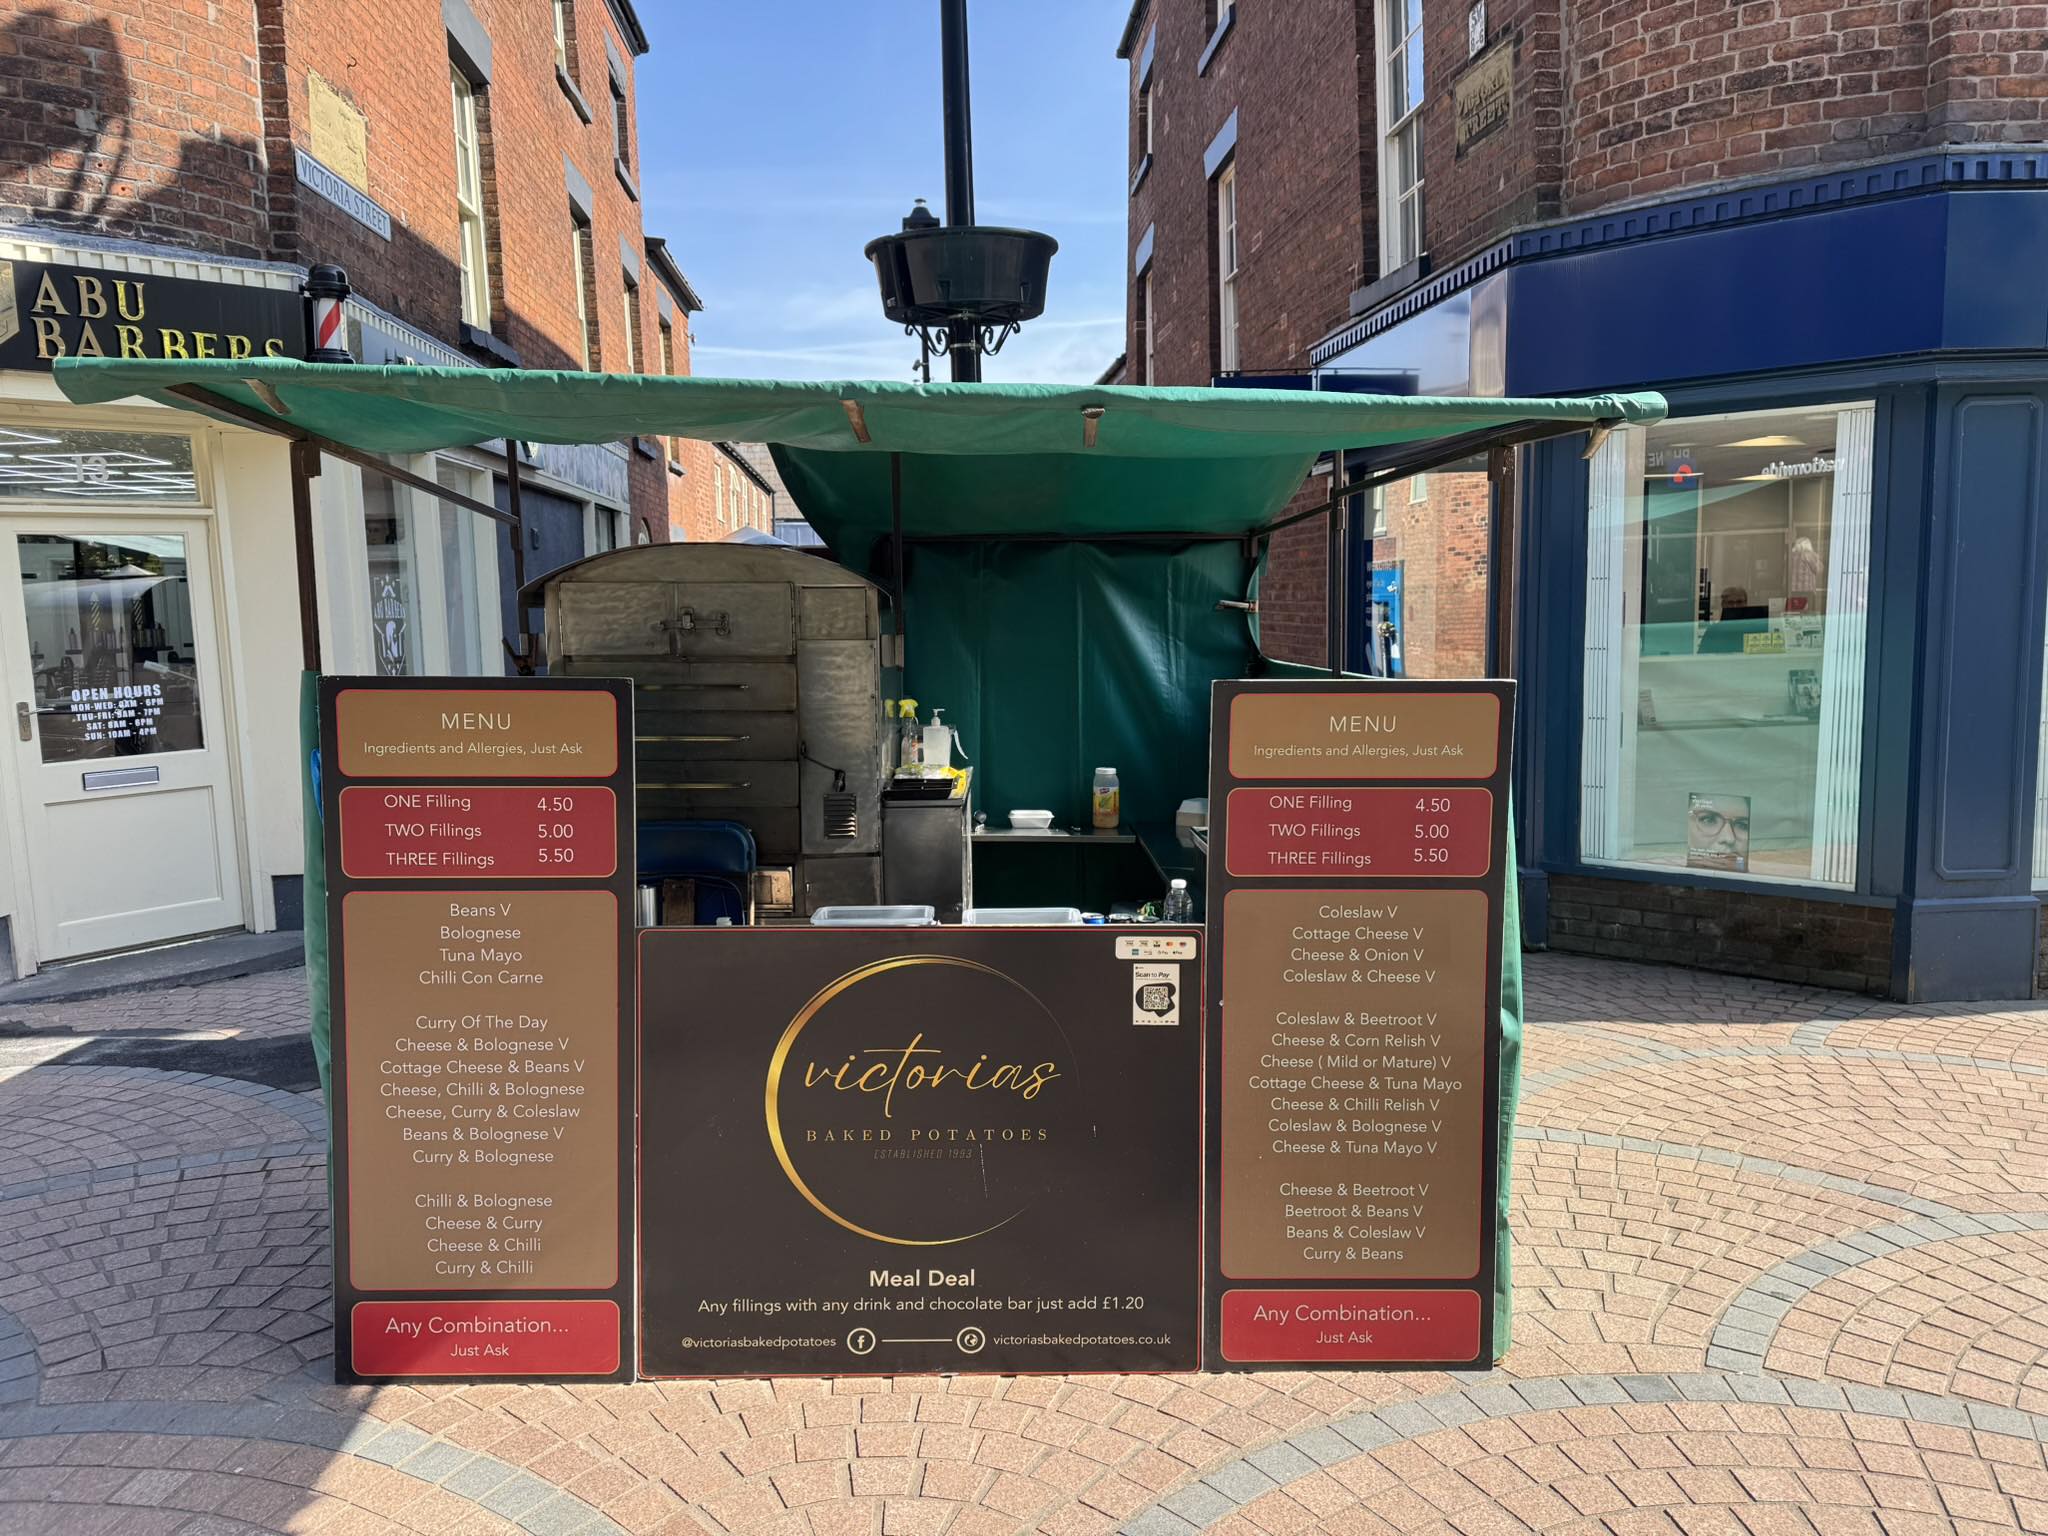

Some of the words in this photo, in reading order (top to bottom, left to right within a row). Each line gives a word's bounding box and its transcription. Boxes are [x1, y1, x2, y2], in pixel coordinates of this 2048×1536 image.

[300, 155, 351, 210] VICTORIA
[353, 195, 387, 234] STREET
[31, 270, 145, 321] ABU
[71, 456, 109, 483] 13
[71, 687, 108, 702] OPEN
[113, 684, 162, 699] HOURS
[70, 702, 117, 712] MON-WED:
[76, 712, 115, 722] THU-FRI:
[144, 707, 161, 716] 7PM
[86, 721, 106, 731] SAT:
[441, 712, 511, 730] MENU
[1329, 715, 1397, 733] MENU
[84, 731, 106, 741] SUN:
[108, 729, 131, 739] 10AM
[139, 727, 157, 737] 4PM
[364, 741, 437, 757] Ingredients
[439, 741, 464, 754] and
[467, 741, 527, 757] Allergies,
[530, 742, 557, 755] Just
[559, 742, 583, 754] Ask
[1254, 744, 1323, 759] Ingredients
[1325, 743, 1349, 757] and
[1351, 743, 1409, 759] Allergies,
[1411, 744, 1438, 756] Just
[1440, 743, 1464, 756] Ask
[383, 794, 422, 809] ONE
[426, 793, 471, 812] Filling
[537, 797, 573, 812] 4.50
[1269, 795, 1305, 809] ONE
[1309, 795, 1353, 813] Filling
[1415, 797, 1451, 813] 4.50
[384, 823, 425, 837] TWO
[429, 823, 482, 841] Fillings
[537, 823, 574, 839] 5.00
[1268, 823, 1307, 837] TWO
[1311, 823, 1361, 841] Fillings
[1414, 823, 1450, 839] 5.00
[385, 852, 438, 866] THREE
[442, 851, 495, 869] Fillings
[538, 847, 574, 863] 5.50
[1267, 851, 1317, 865] THREE
[1321, 851, 1372, 869] Fillings
[1413, 847, 1449, 863] 5.50
[450, 903, 496, 917] Beans
[499, 903, 512, 917] V
[1318, 904, 1384, 919] Coleslaw
[1387, 905, 1398, 919] V
[440, 925, 521, 943] Bolognese
[1292, 926, 1351, 944] Cottage
[1354, 926, 1409, 941] Cheese
[1412, 927, 1424, 941] V
[439, 947, 475, 962] Tuna
[480, 947, 523, 966] Mayo
[419, 969, 457, 985] Chilli
[461, 970, 493, 985] Con
[497, 969, 544, 985] Carne
[415, 1015, 457, 1033] Curry
[461, 1014, 481, 1029] Of
[484, 1014, 514, 1029] The
[519, 1015, 548, 1033] Day
[1275, 1011, 1341, 1025] Coleslaw
[1343, 1011, 1355, 1026] &
[1360, 1012, 1423, 1026] Beetroot
[1426, 1013, 1437, 1026] V
[1271, 1032, 1325, 1047] Cheese
[1329, 1033, 1341, 1047] &
[1344, 1033, 1380, 1047] Corn
[1385, 1033, 1426, 1048] Relish
[1430, 1034, 1441, 1048] V
[380, 1060, 442, 1078] Cottage
[446, 1059, 503, 1074] Cheese
[507, 1059, 520, 1074] &
[525, 1059, 570, 1073] Beans
[573, 1059, 585, 1073] V
[804, 1032, 1062, 1119] victorias
[380, 1082, 441, 1099] Cheese,
[446, 1081, 483, 1097] Chilli
[488, 1082, 500, 1096] &
[505, 1081, 585, 1099] Bolognese
[1249, 1075, 1307, 1093] Cottage
[1311, 1075, 1365, 1090] Cheese
[1368, 1075, 1380, 1090] &
[1383, 1076, 1418, 1090] Tuna
[1423, 1077, 1463, 1094] Mayo
[385, 1104, 447, 1121] Cheese,
[451, 1104, 493, 1122] Curry
[496, 1104, 509, 1118] &
[513, 1103, 581, 1119] Coleslaw
[807, 1129, 891, 1142] BAKED
[911, 1128, 1047, 1141] POTATOES
[1272, 1139, 1326, 1154] Cheese
[1329, 1140, 1341, 1154] &
[1345, 1140, 1379, 1154] Tuna
[1383, 1140, 1423, 1158] Mayo
[1426, 1141, 1438, 1154] V
[415, 1193, 452, 1208] Chilli
[456, 1193, 469, 1208] &
[473, 1193, 553, 1211] Bolognese
[1285, 1203, 1347, 1218] Beetroot
[1350, 1204, 1362, 1218] &
[1367, 1204, 1409, 1218] Beans
[1412, 1205, 1424, 1217] V
[869, 1268, 921, 1287] Meal
[928, 1268, 975, 1287] Deal
[697, 1299, 729, 1316] Any
[732, 1297, 782, 1316] fillings
[785, 1297, 817, 1312] with
[821, 1301, 849, 1315] any
[853, 1296, 892, 1311] drink
[895, 1296, 925, 1311] and
[929, 1296, 1003, 1311] chocolate
[1007, 1295, 1032, 1311] bar
[1036, 1295, 1064, 1314] just
[1067, 1295, 1097, 1311] add
[1102, 1295, 1145, 1311] £1.20
[1253, 1304, 1290, 1326] Any
[1295, 1303, 1431, 1321] Combination...
[385, 1317, 423, 1339] Any
[428, 1315, 569, 1334] Combination...
[681, 1335, 837, 1351] @victoriasbakedpotatoes
[993, 1333, 1171, 1348] victoriasbakedpotatoes.co.uk
[1315, 1331, 1345, 1344] Just
[1347, 1330, 1373, 1344] Ask
[450, 1343, 480, 1357] Just
[483, 1343, 510, 1357] Ask
